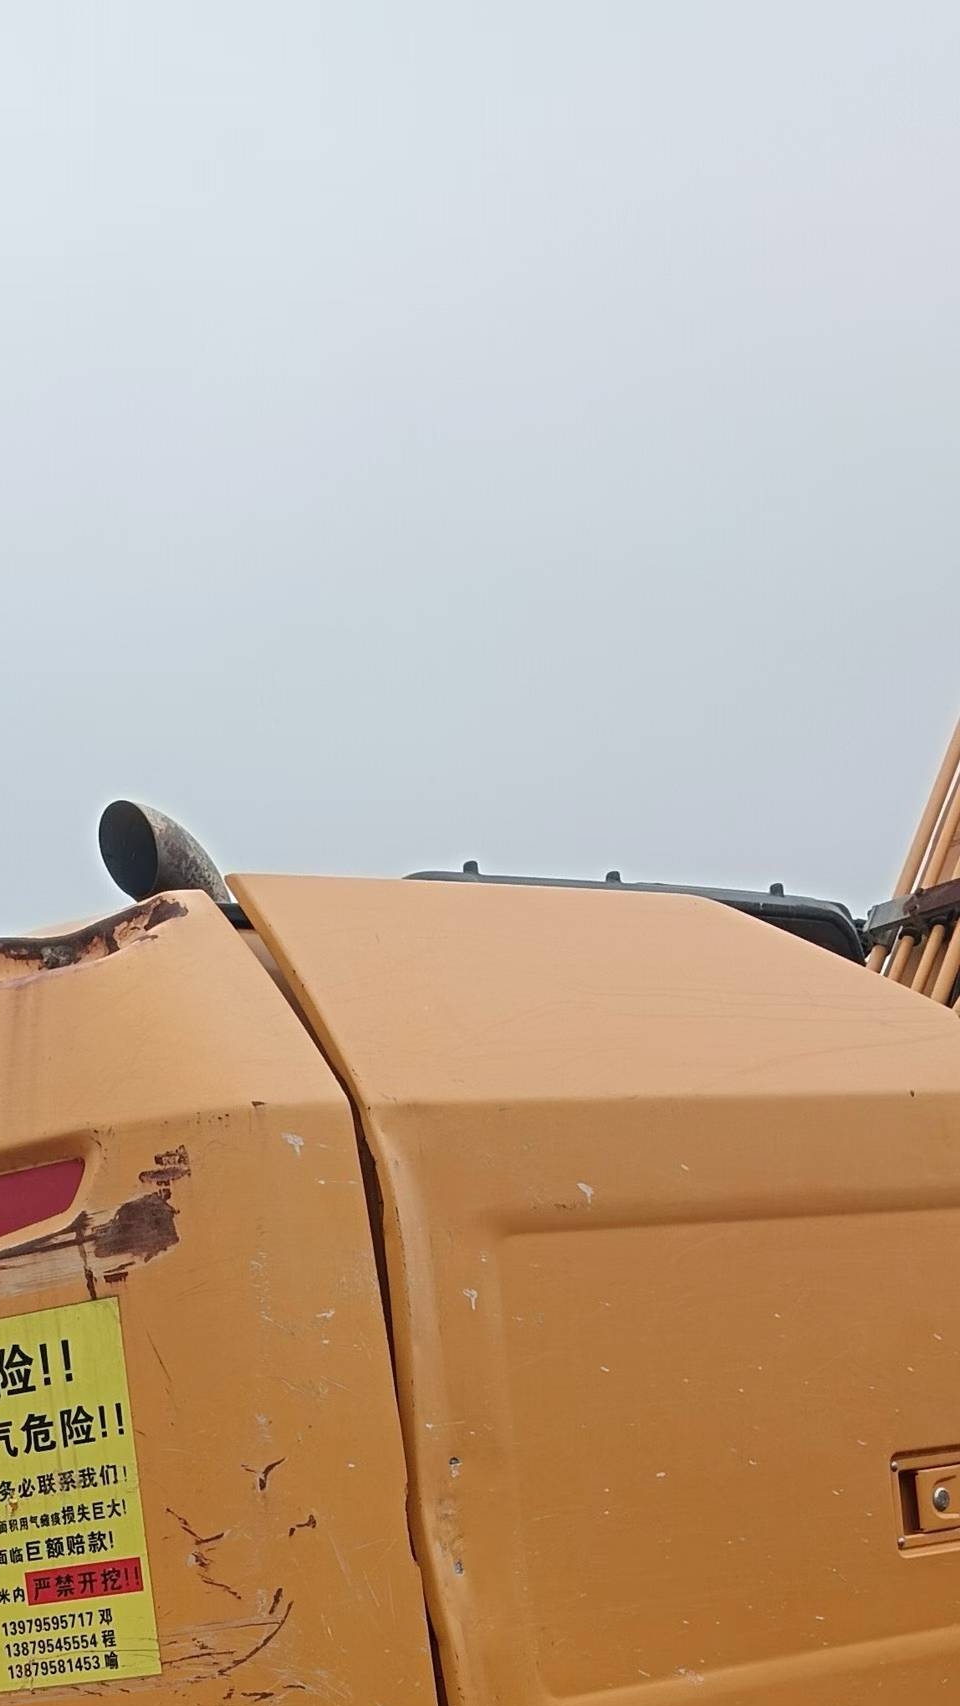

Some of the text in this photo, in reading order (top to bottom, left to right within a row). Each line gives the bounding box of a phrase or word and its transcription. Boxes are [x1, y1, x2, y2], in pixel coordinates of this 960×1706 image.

[1, 1611, 94, 1637] 13979595717
[4, 1635, 98, 1658] 13879545554
[7, 1656, 101, 1680] 13879581453
